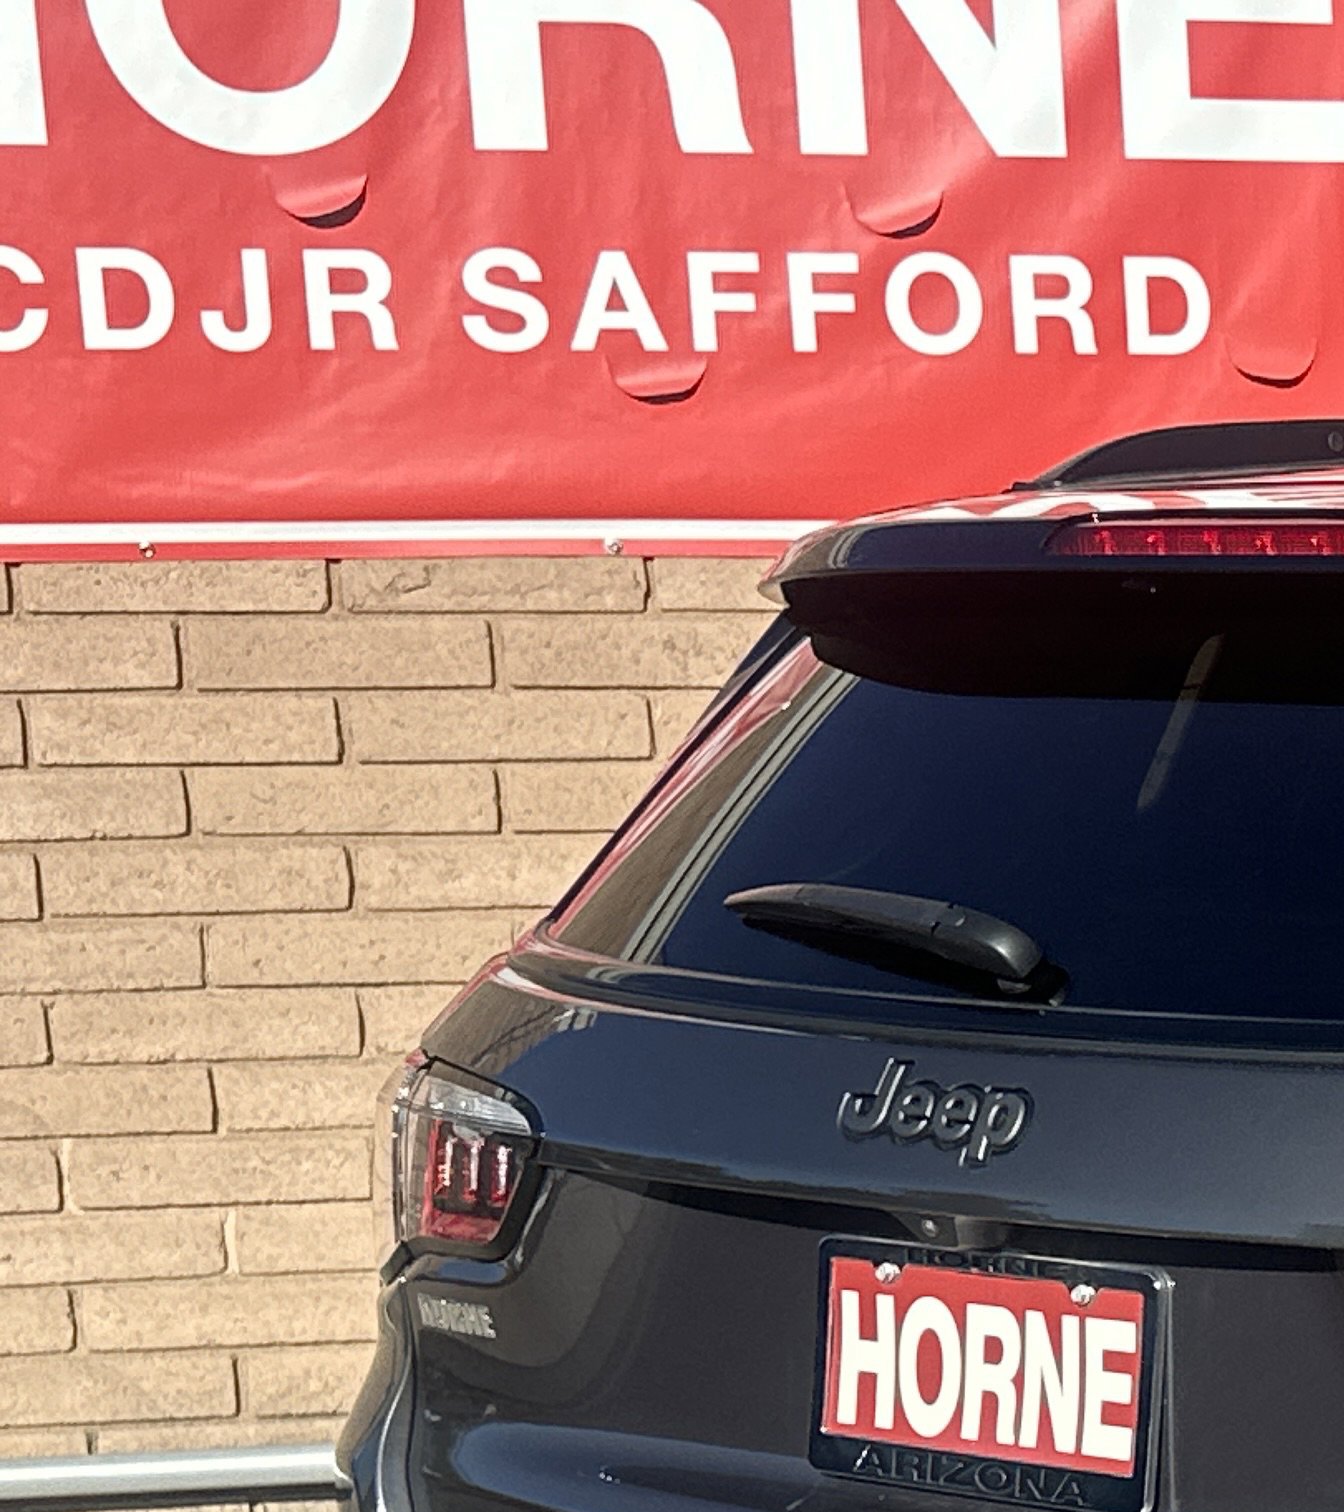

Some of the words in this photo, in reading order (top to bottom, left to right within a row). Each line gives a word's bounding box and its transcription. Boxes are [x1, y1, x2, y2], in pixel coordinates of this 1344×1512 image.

[462, 249, 1212, 356] SAFFORD
[836, 1056, 1033, 1168] Jeep
[835, 1289, 1139, 1462] HORNE
[852, 1443, 1087, 1507] ARIZONA
